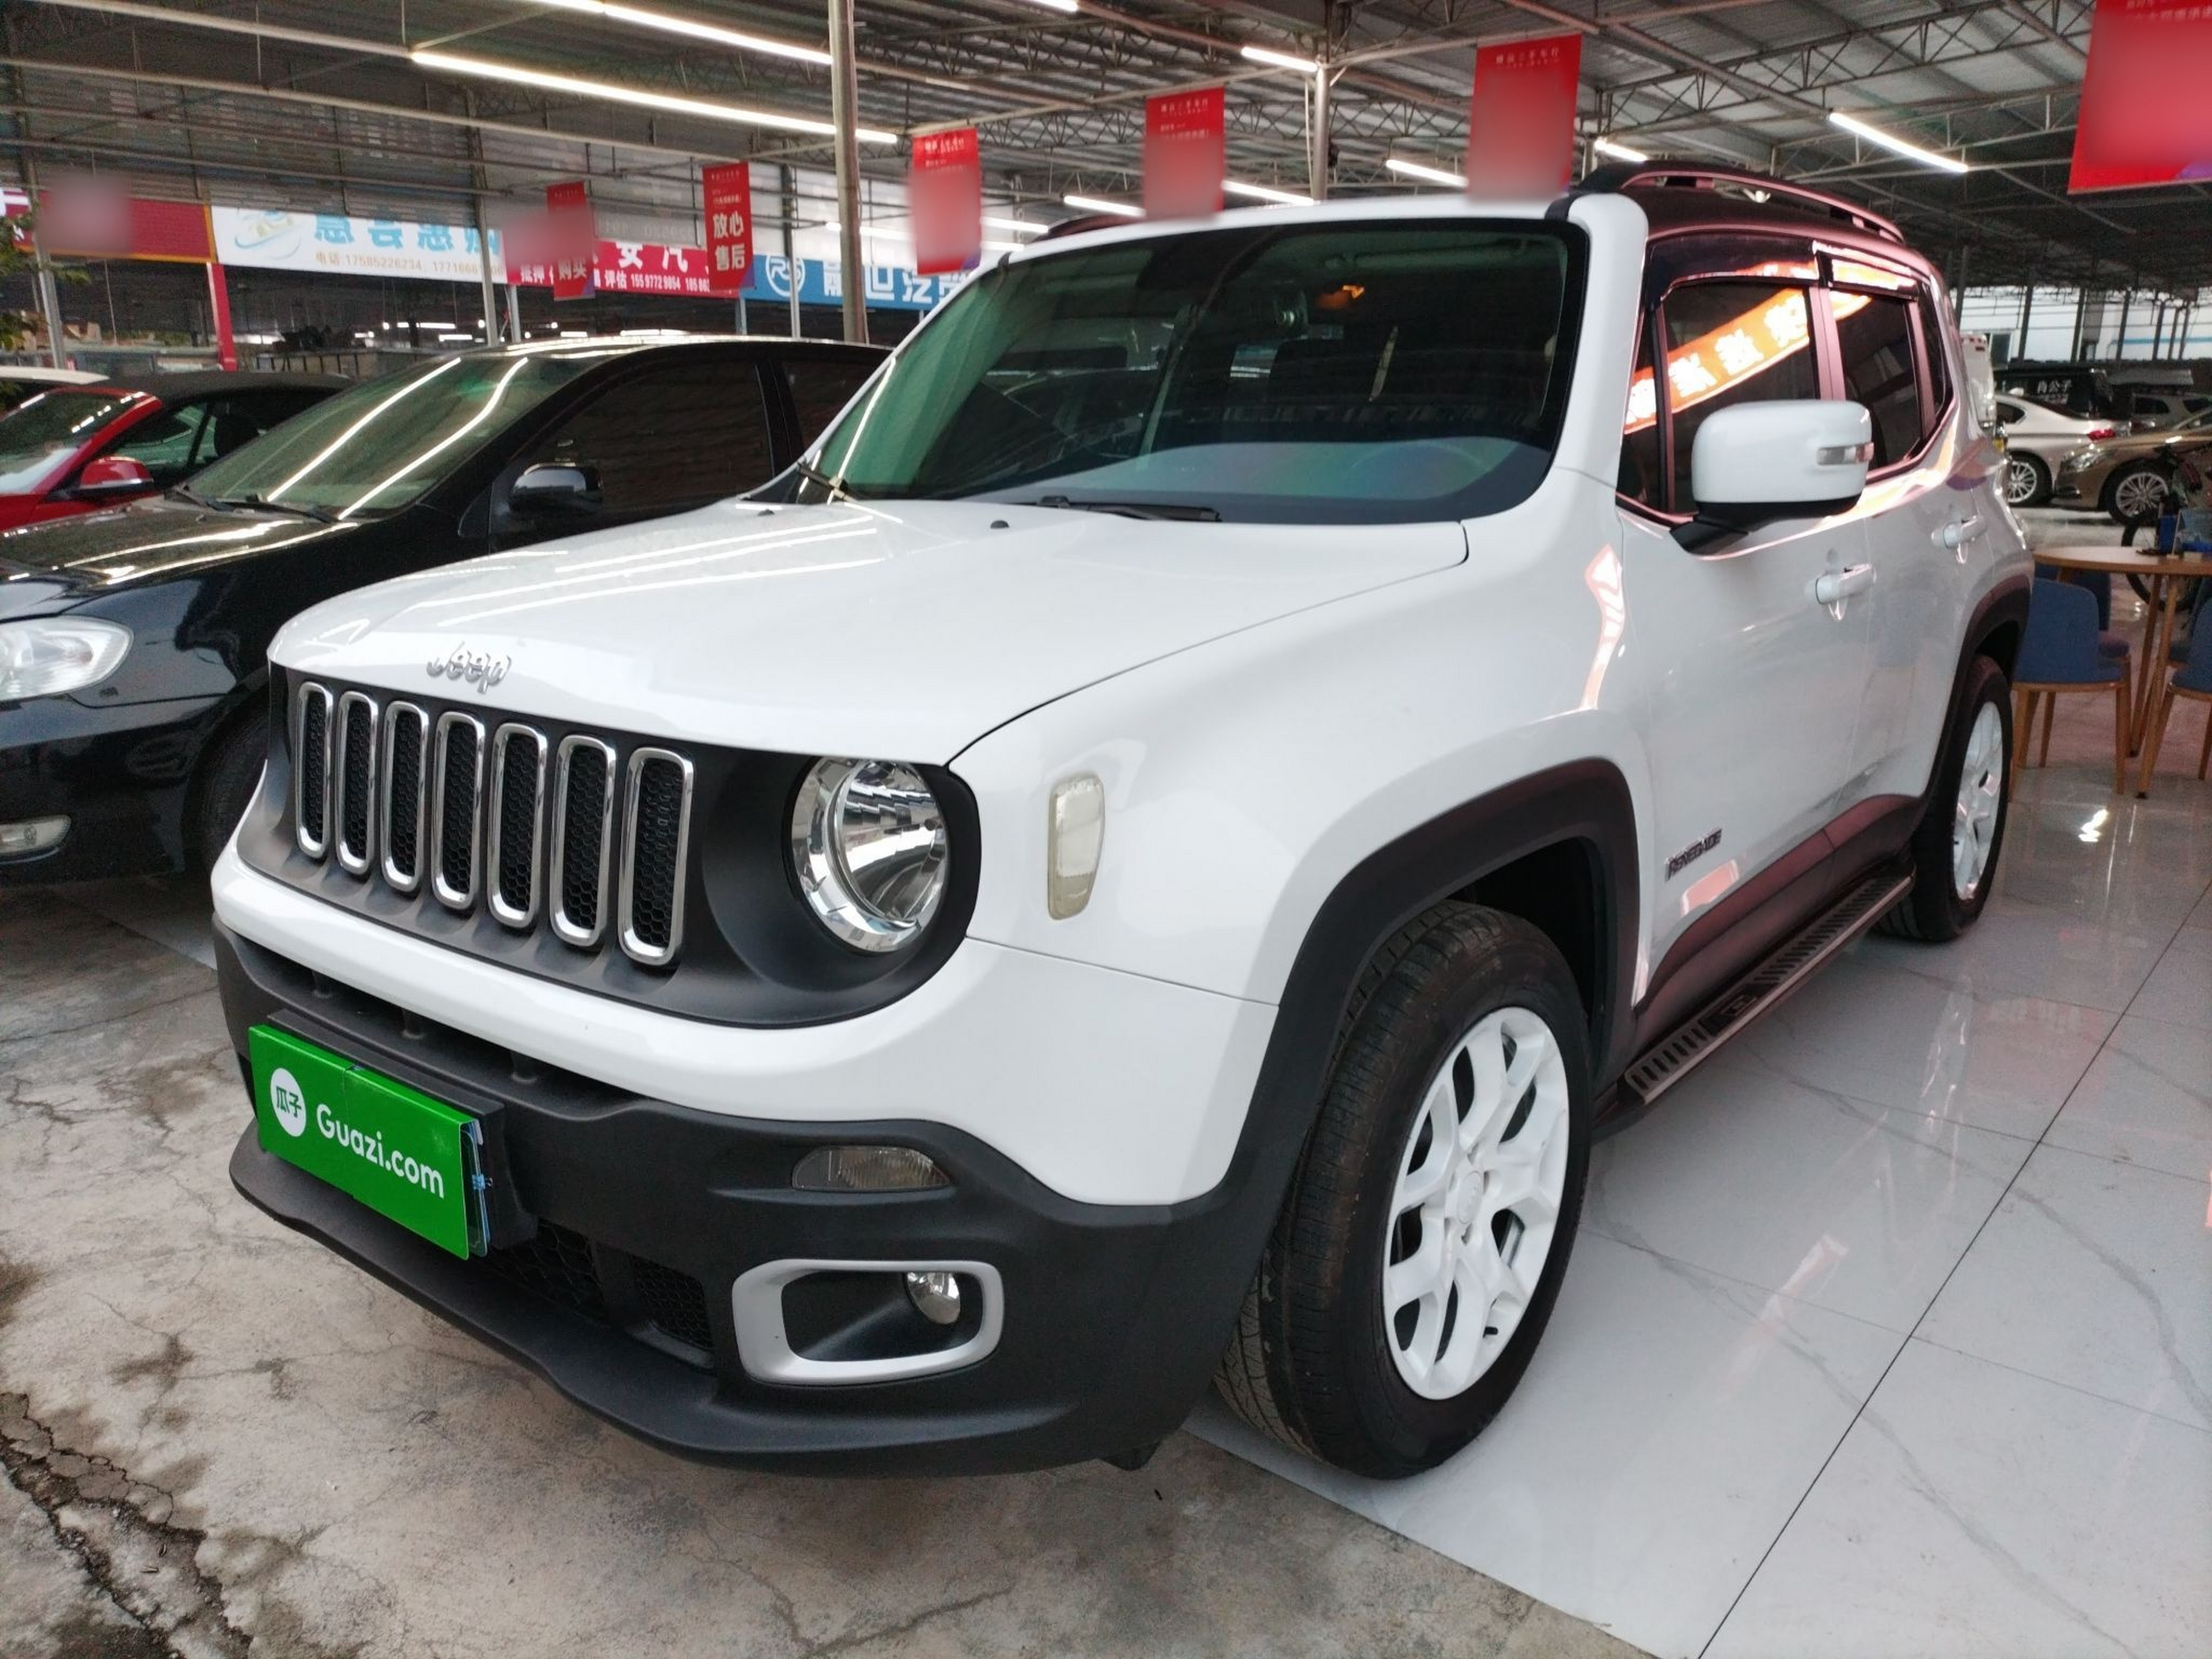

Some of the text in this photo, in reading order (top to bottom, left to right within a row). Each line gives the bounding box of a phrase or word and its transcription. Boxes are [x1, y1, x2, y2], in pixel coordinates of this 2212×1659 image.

[713, 211, 744, 238] 放心
[715, 243, 746, 271] 售后
[426, 641, 512, 695] Jeep
[276, 1085, 302, 1119] 瓜子
[317, 1103, 445, 1199] Guazi.com
